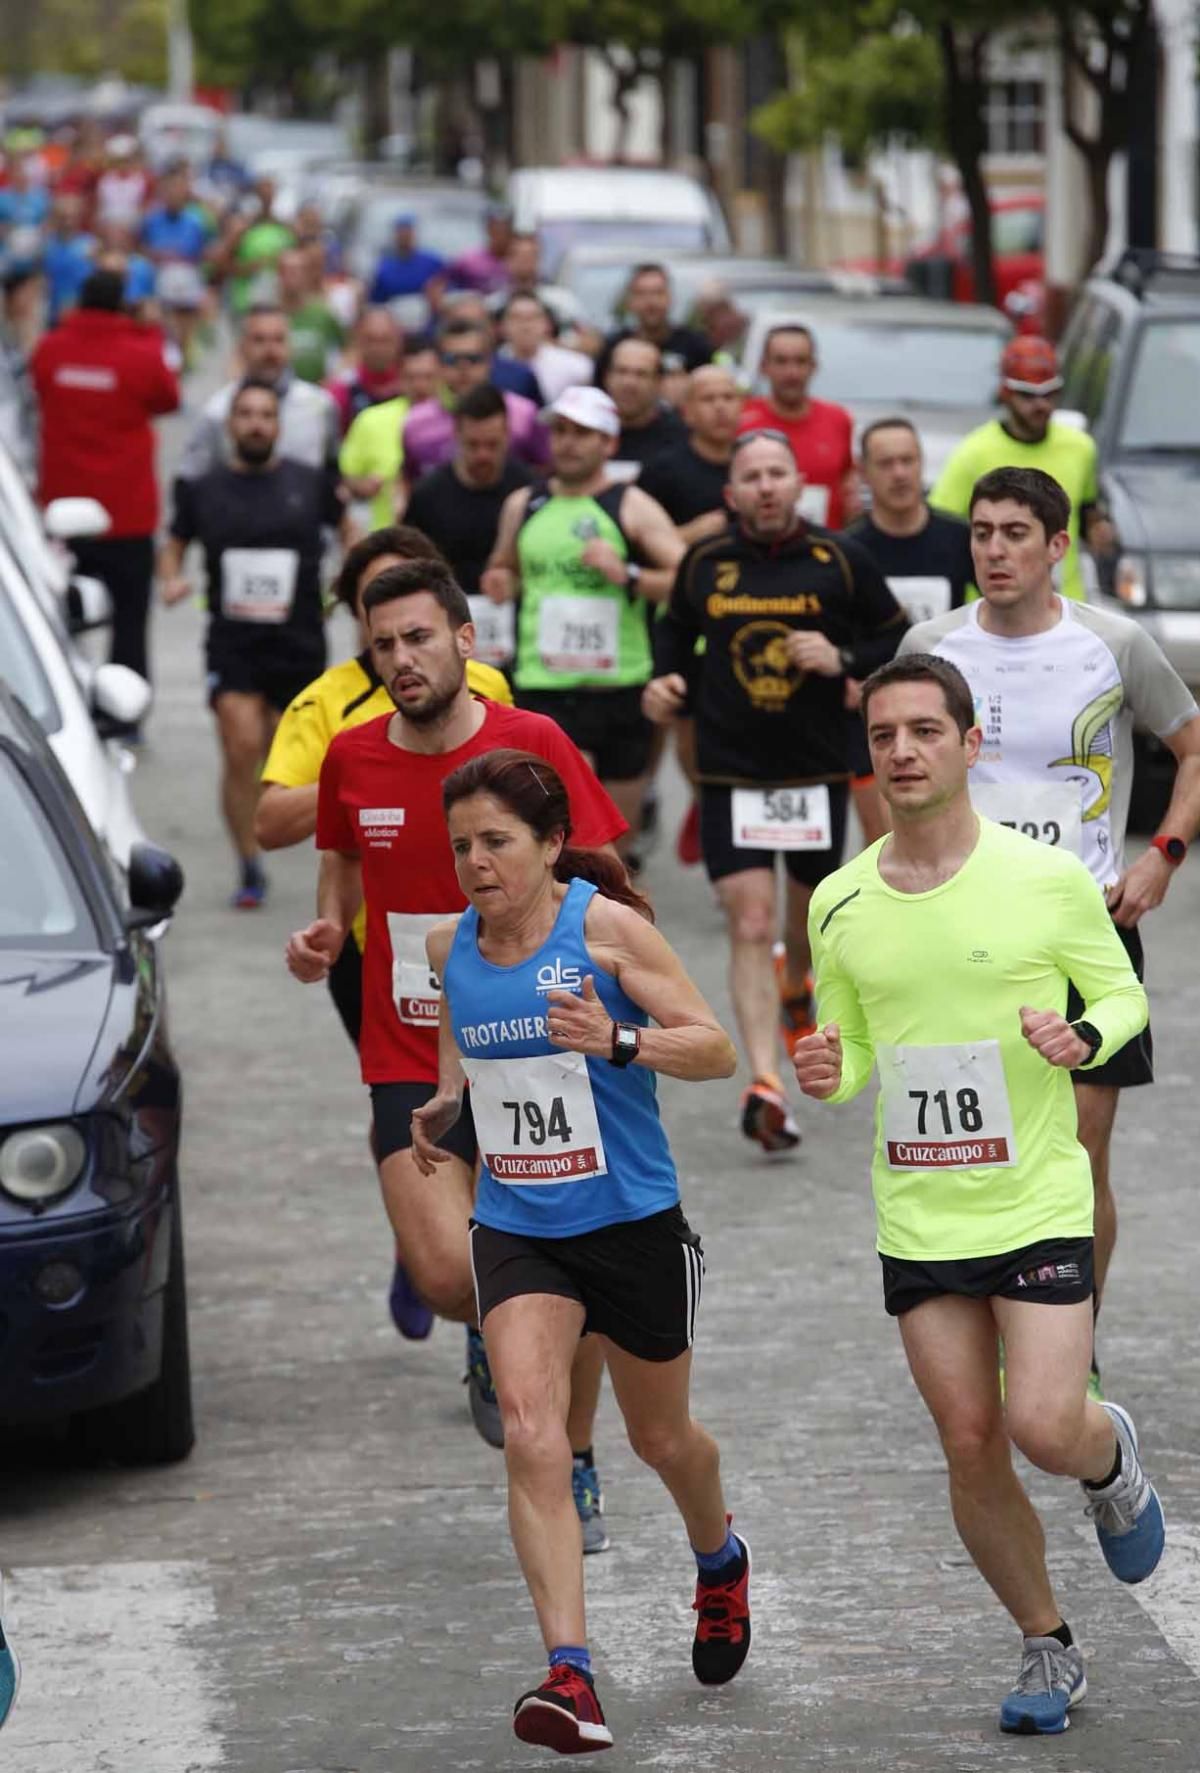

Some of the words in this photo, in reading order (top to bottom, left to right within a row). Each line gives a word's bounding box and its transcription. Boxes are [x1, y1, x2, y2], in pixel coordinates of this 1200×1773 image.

[763, 788, 808, 822] 584
[537, 957, 582, 985] als
[461, 1014, 550, 1049] TROTASIER
[502, 1096, 573, 1146] 794
[908, 1087, 984, 1135] 718
[493, 1155, 572, 1177] Cruzcampo
[895, 1143, 983, 1164] Cruzcampo
